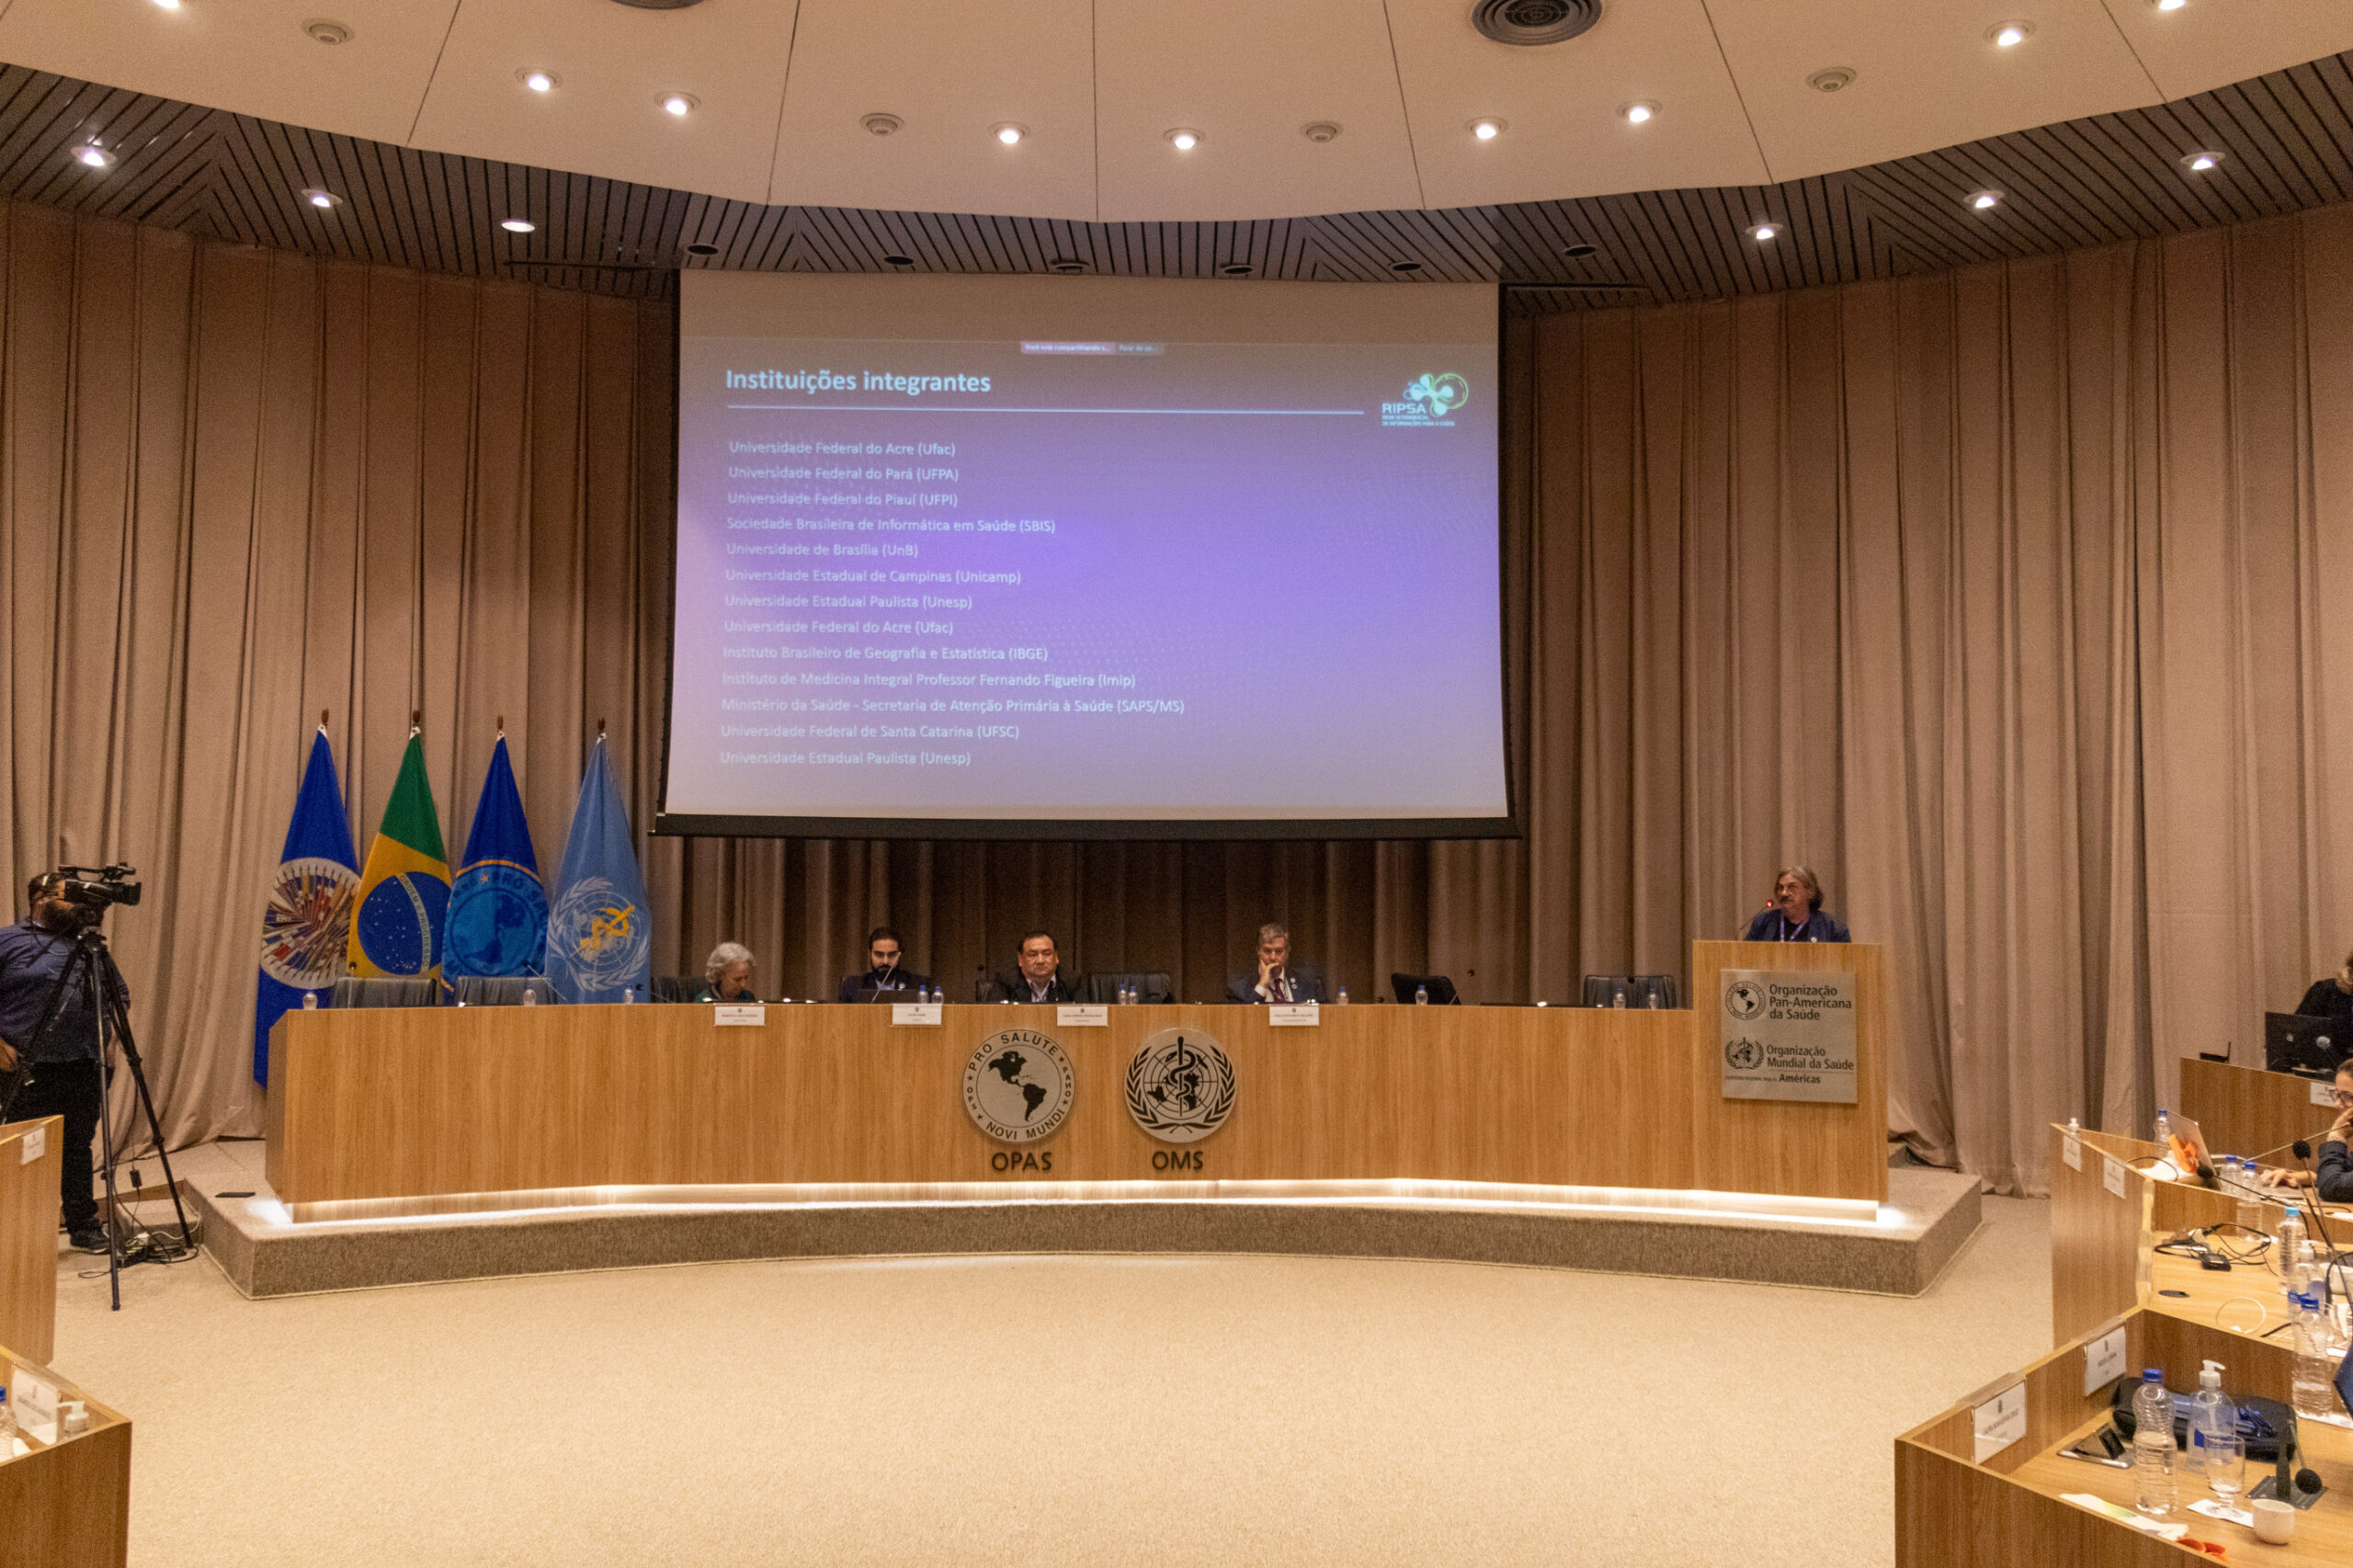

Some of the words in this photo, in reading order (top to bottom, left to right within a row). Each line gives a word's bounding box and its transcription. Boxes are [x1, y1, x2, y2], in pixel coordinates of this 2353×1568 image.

[726, 369, 857, 394] Instituições
[863, 370, 991, 395] integrantes
[1381, 403, 1427, 415] RIPSA
[729, 441, 813, 454] Universidade
[815, 442, 863, 454] Federal
[866, 443, 882, 455] do
[885, 443, 915, 455] Acre
[917, 442, 956, 458] (Ufac)
[728, 466, 813, 479] Universidade
[815, 467, 863, 479] Federal
[865, 468, 881, 480] do
[885, 467, 913, 480] Pará
[916, 467, 959, 483] (UFPA)
[727, 492, 811, 505] Universidade
[814, 493, 861, 505] Federal
[865, 494, 881, 506] do
[885, 493, 916, 506] Piauí
[919, 493, 958, 507] (UFPI)
[727, 517, 792, 529] Sociedade
[796, 517, 854, 530] Brasileira
[858, 518, 874, 530] de
[878, 517, 950, 531] Informática
[953, 522, 974, 531] em
[977, 519, 1016, 532] Saúde
[1019, 519, 1056, 534] (SBIS)
[726, 542, 810, 555] Universidade
[813, 543, 830, 556] de
[834, 542, 879, 556] Brasília
[882, 543, 918, 559] (UnB)
[725, 568, 810, 582] Universidade
[813, 569, 867, 582] Estadual
[870, 570, 887, 582] de
[890, 570, 952, 585] Campinas
[955, 570, 1021, 585] (Unicamp)
[724, 594, 809, 607] Universidade
[813, 595, 867, 608] Estadual
[870, 595, 919, 608] Paulista
[922, 596, 972, 610] (Unesp)
[723, 619, 809, 632] Universidade
[812, 619, 859, 633] Federal
[862, 620, 880, 633] do
[882, 620, 912, 633] Acre
[915, 620, 953, 636] (Ufac)
[723, 646, 779, 659] Instituto
[781, 646, 841, 659] Brasileiro
[845, 647, 861, 659] de
[864, 646, 926, 662] Geografia
[941, 647, 1006, 661] Estatística
[1008, 647, 1048, 662] (IBGE)
[722, 673, 777, 685] Instituto
[780, 673, 797, 685] de
[801, 673, 860, 686] Medicina
[863, 673, 913, 688] Integral
[915, 673, 975, 687] Professor
[980, 674, 1040, 687] Fernando
[1043, 673, 1095, 688] Figueira
[1098, 674, 1136, 689] (Imip)
[722, 699, 788, 711] Ministério
[791, 699, 808, 711] da
[811, 699, 850, 711] Saúde
[862, 699, 926, 711] Secretaria
[930, 699, 947, 712] de
[950, 699, 1003, 715] Atenção
[1006, 699, 1060, 713] Primária
[1074, 700, 1114, 713] Saúde
[1117, 699, 1185, 715] (SAPS/MS)
[721, 724, 806, 737] Universidade
[810, 724, 858, 738] Federal
[860, 725, 877, 738] de
[881, 725, 916, 738] Santa
[920, 725, 973, 738] Catarina
[977, 725, 1020, 740] (UFSC)
[720, 751, 805, 764] Universidade
[809, 751, 863, 764] Estadual
[866, 751, 916, 765] Paulista
[920, 751, 972, 767] (Unesp)
[1769, 983, 1837, 998] Organização
[1768, 996, 1853, 1009] Pan-Americana
[1769, 1008, 1783, 1019] da
[1786, 1008, 1821, 1020] Saúde
[969, 1043, 993, 1072] PRO
[1000, 1032, 1059, 1056] SALUTE
[1767, 1044, 1825, 1058] Organização
[1767, 1057, 1806, 1069] Mundial
[1809, 1058, 1822, 1069] da
[1824, 1059, 1855, 1071] Saúde
[1062, 1066, 1072, 1098] PAHO
[1779, 1073, 1822, 1085] Américas
[985, 1120, 1017, 1141] NOVI
[1025, 1109, 1065, 1140] MUNDI
[992, 1152, 1052, 1172] OPAS
[1152, 1150, 1204, 1172] OMS
